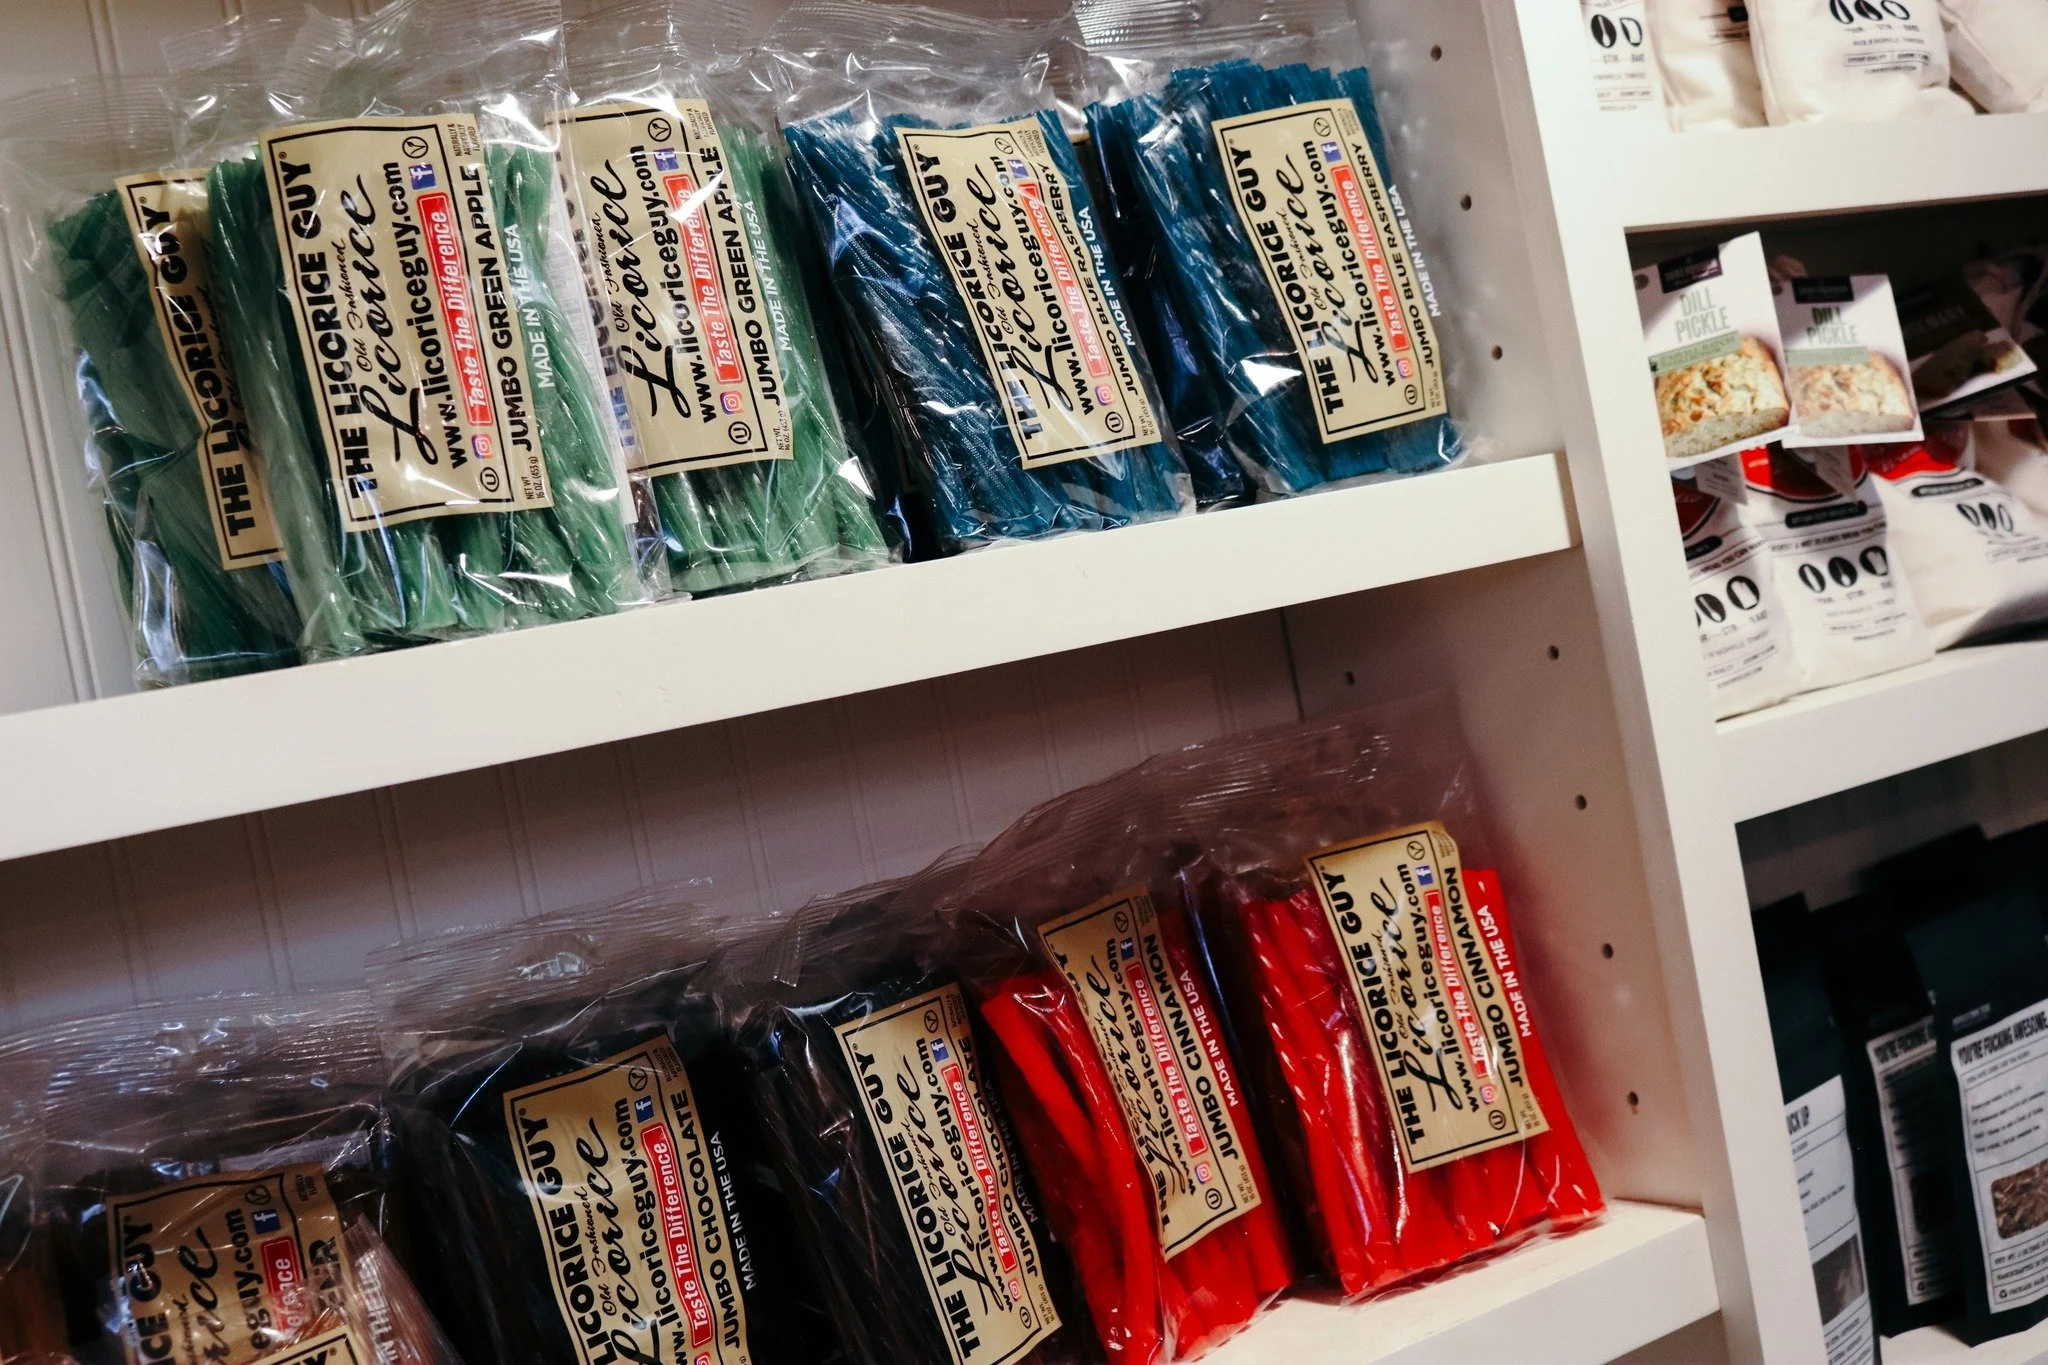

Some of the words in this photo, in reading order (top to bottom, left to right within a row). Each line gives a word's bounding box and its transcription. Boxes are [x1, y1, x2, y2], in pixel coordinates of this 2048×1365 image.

[280, 161, 322, 239] GUY
[459, 165, 495, 250] APPLE
[915, 151, 957, 223] GUY
[1230, 146, 1267, 212] GUY
[1352, 142, 1398, 248] RASPBERRY
[1388, 184, 1406, 217] USA
[143, 207, 188, 285] GUY
[504, 224, 524, 263] USA
[744, 201, 763, 235] USA
[1029, 200, 1073, 281] Difference
[1037, 162, 1088, 272] RASPBERRY
[1078, 206, 1096, 241] USA
[1341, 180, 1379, 260] Difference
[1399, 219, 1418, 250] THE
[331, 238, 363, 331] Fashioned
[431, 211, 467, 312] Difference
[511, 266, 529, 305] THE
[590, 159, 691, 418] Licorice
[630, 145, 717, 423] www.licoriceguy.com
[723, 230, 757, 314] GREEN
[752, 239, 770, 272] THE
[764, 276, 779, 296] IN
[966, 218, 1001, 300] Fashioned
[966, 163, 1074, 411] Licorice
[989, 156, 1095, 415] www.licoriceguy.com
[1090, 244, 1106, 276] THE
[1101, 280, 1116, 296] IN
[1256, 220, 1326, 350] LICORICE
[1276, 154, 1379, 384] Licorice
[1302, 140, 1396, 387] www.licoriceguy.com
[1372, 263, 1390, 292] The
[1392, 253, 1414, 300] BLUE
[1411, 252, 1426, 268] IN
[341, 174, 439, 465] Licorice
[383, 162, 468, 469] www.licoriceguy.com
[478, 257, 512, 349] GREEN
[521, 308, 543, 327] IN
[611, 301, 630, 332] Old
[700, 285, 721, 316] The
[769, 299, 793, 351] MADE
[944, 232, 1017, 370] LICORICE
[1067, 286, 1085, 315] The
[1085, 277, 1110, 325] BLUE
[1109, 299, 1136, 346] MADE
[1384, 295, 1404, 336] Taste
[1418, 271, 1442, 317] MADE
[1674, 306, 1732, 343] PICKLE
[1680, 286, 1716, 317] DILL
[298, 252, 362, 415] LICORICE
[353, 338, 373, 372] Old
[455, 317, 474, 351] The
[530, 332, 555, 389] MADE
[710, 321, 735, 367] Taste
[745, 319, 781, 407] JUMBO
[1079, 319, 1102, 361] Taste
[1106, 329, 1138, 396] JUMBO
[1409, 304, 1434, 368] JUMBO
[172, 295, 240, 455] LICORICE
[463, 356, 487, 408] Taste
[497, 356, 532, 452] JUMBO
[1313, 356, 1345, 415] THE
[1007, 379, 1043, 440] THE
[340, 427, 378, 498] THE
[219, 463, 256, 536] THE
[1321, 872, 1362, 935] GUY
[1444, 866, 1495, 998] CINNAMON
[1476, 904, 1499, 938] USA
[1431, 905, 1461, 987] Difference
[1489, 938, 1511, 970] THE
[1144, 933, 1202, 1071] CINNAMON
[1179, 969, 1200, 1005] USA
[1351, 942, 1407, 1079] LICORICE
[1370, 877, 1463, 1113] Licorice
[1397, 863, 1480, 1113] www.licoriceguy.com
[1452, 990, 1472, 1020] The
[1502, 970, 1520, 989] IN
[1135, 979, 1172, 1063] Difference
[1193, 1004, 1212, 1039] THE
[1486, 1004, 1523, 1088] JUMBO
[1509, 990, 1532, 1038] MADE
[1106, 937, 1196, 1196] www.licoriceguy.com
[1165, 1065, 1183, 1096] The
[1206, 1038, 1221, 1058] IN
[854, 1052, 894, 1125] GUY
[958, 1035, 1009, 1188] CHOCOLATE
[1214, 1058, 1239, 1107] MADE
[1396, 1086, 1425, 1145] THE
[711, 1131, 728, 1171] USA
[952, 1081, 988, 1170] Difference
[1177, 1097, 1201, 1143] Taste
[1196, 1076, 1239, 1160] JUMBO
[519, 1117, 563, 1195] GUY
[670, 1089, 722, 1254] CHOCOLATE
[897, 1055, 1005, 1316] Licorice
[915, 1037, 1013, 1313] www.licoriceguy.com
[653, 1142, 686, 1239] Difference
[720, 1172, 738, 1211] THE
[729, 1212, 744, 1234] IN
[887, 1132, 958, 1288] LICORICE
[984, 1174, 996, 1206] The
[1013, 1172, 1039, 1224] MADE
[124, 1224, 162, 1302] GUY
[574, 1186, 606, 1278] Fashioned
[614, 1097, 688, 1365] ww.licoriceguy.com
[675, 1243, 693, 1278] The
[735, 1235, 757, 1291] MADE
[991, 1210, 1010, 1257] Taste
[1003, 1193, 1038, 1278] JUMBO
[549, 1203, 618, 1365] LICORICE
[598, 1283, 617, 1316] Old
[684, 1280, 709, 1330] Taste
[709, 1259, 741, 1349] JUMBO
[943, 1289, 981, 1359] THE
